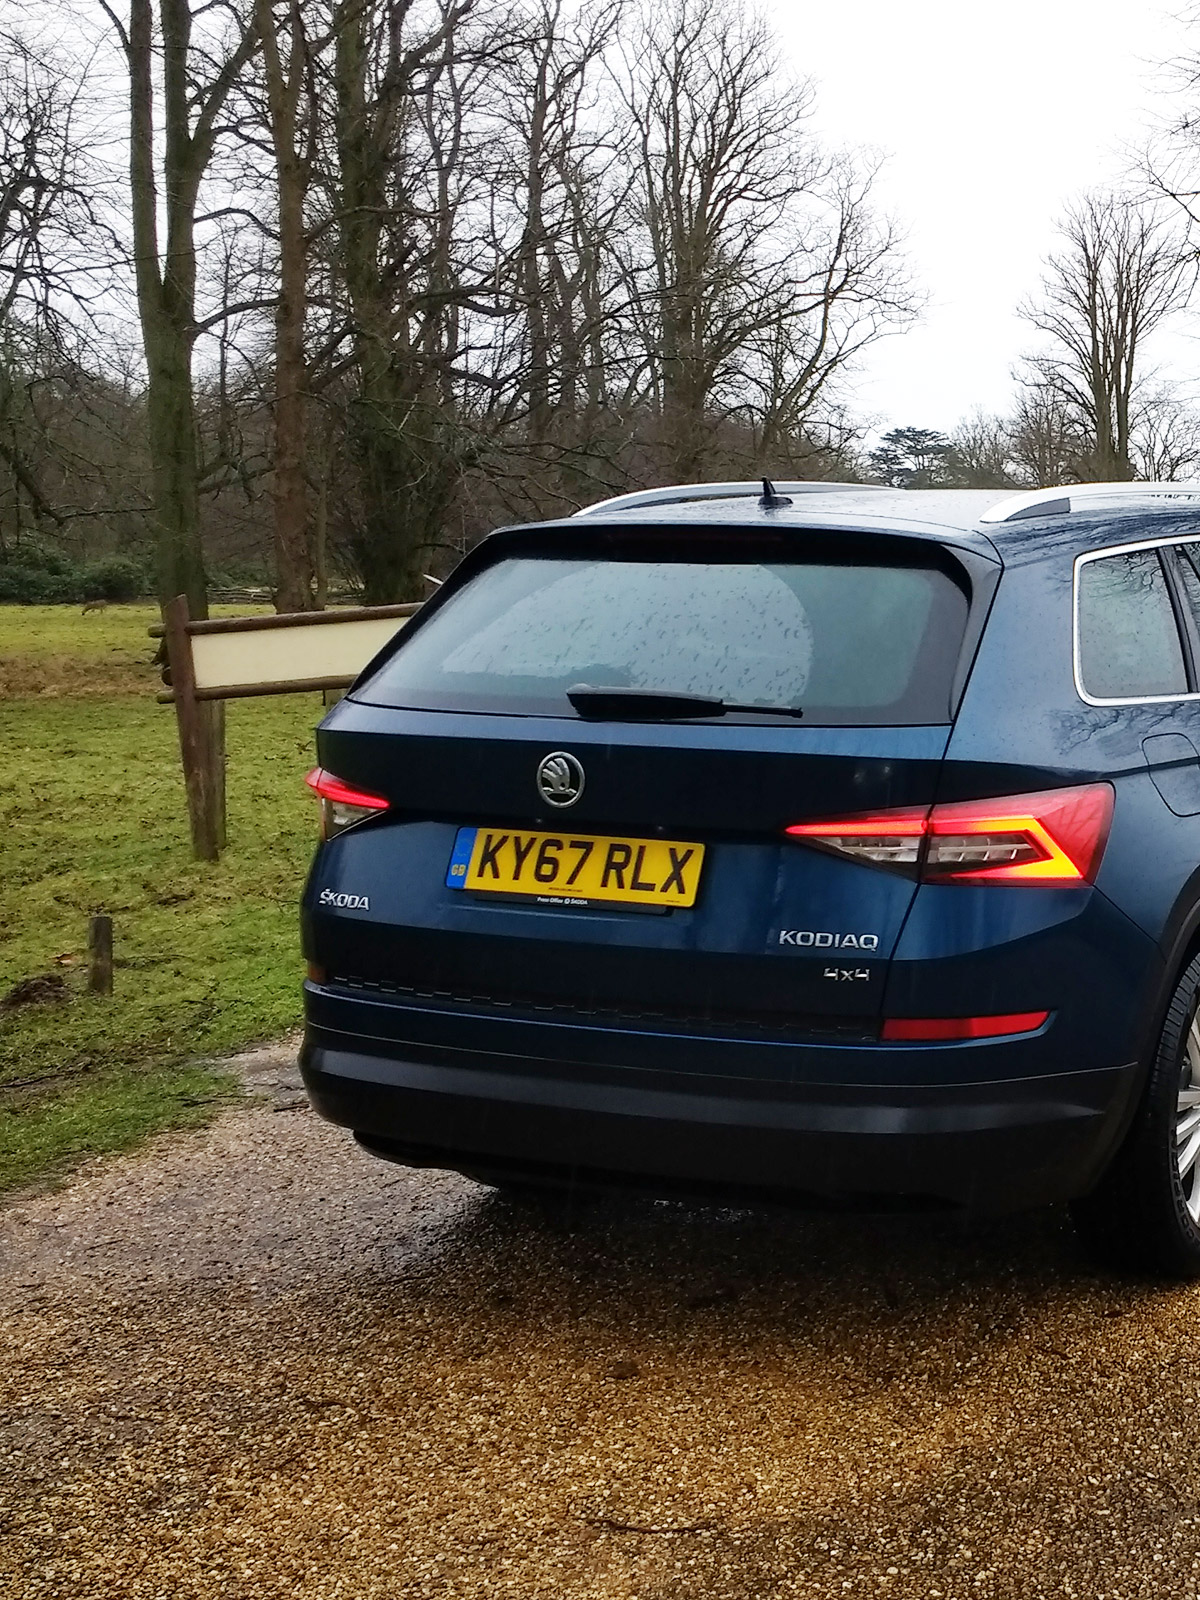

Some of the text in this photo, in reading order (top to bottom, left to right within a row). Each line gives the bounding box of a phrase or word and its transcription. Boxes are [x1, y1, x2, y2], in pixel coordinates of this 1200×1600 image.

[477, 834, 694, 894] KY67 RLX
[779, 930, 879, 952] KODIAQ
[823, 968, 870, 981] 4x4
